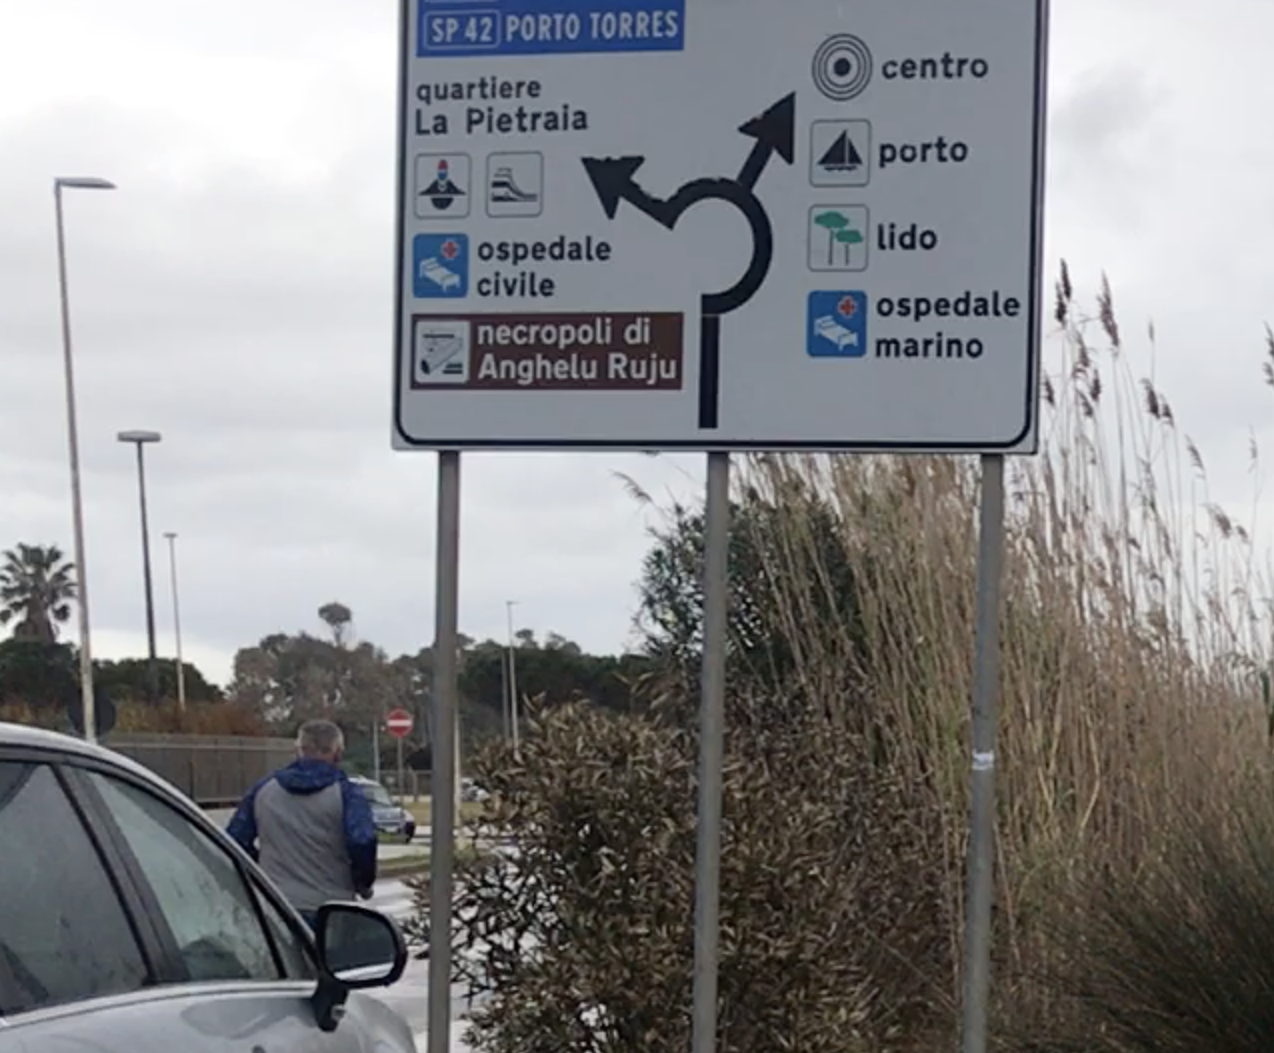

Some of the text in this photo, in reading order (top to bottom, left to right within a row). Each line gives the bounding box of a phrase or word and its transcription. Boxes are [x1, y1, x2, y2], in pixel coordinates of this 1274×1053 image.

[432, 10, 678, 43] SP 42 PORTO TORRES
[881, 53, 989, 80] centro
[416, 76, 541, 105] quartiere
[415, 104, 588, 136] La Pietraia
[879, 137, 968, 168] porto
[477, 236, 612, 264] ospedale
[877, 222, 938, 251] lido
[477, 271, 555, 298] civile
[876, 291, 1021, 322] ospedale
[477, 317, 650, 349] necropoli di
[875, 331, 983, 359] marino
[477, 353, 676, 386] Anghelu Ruju
